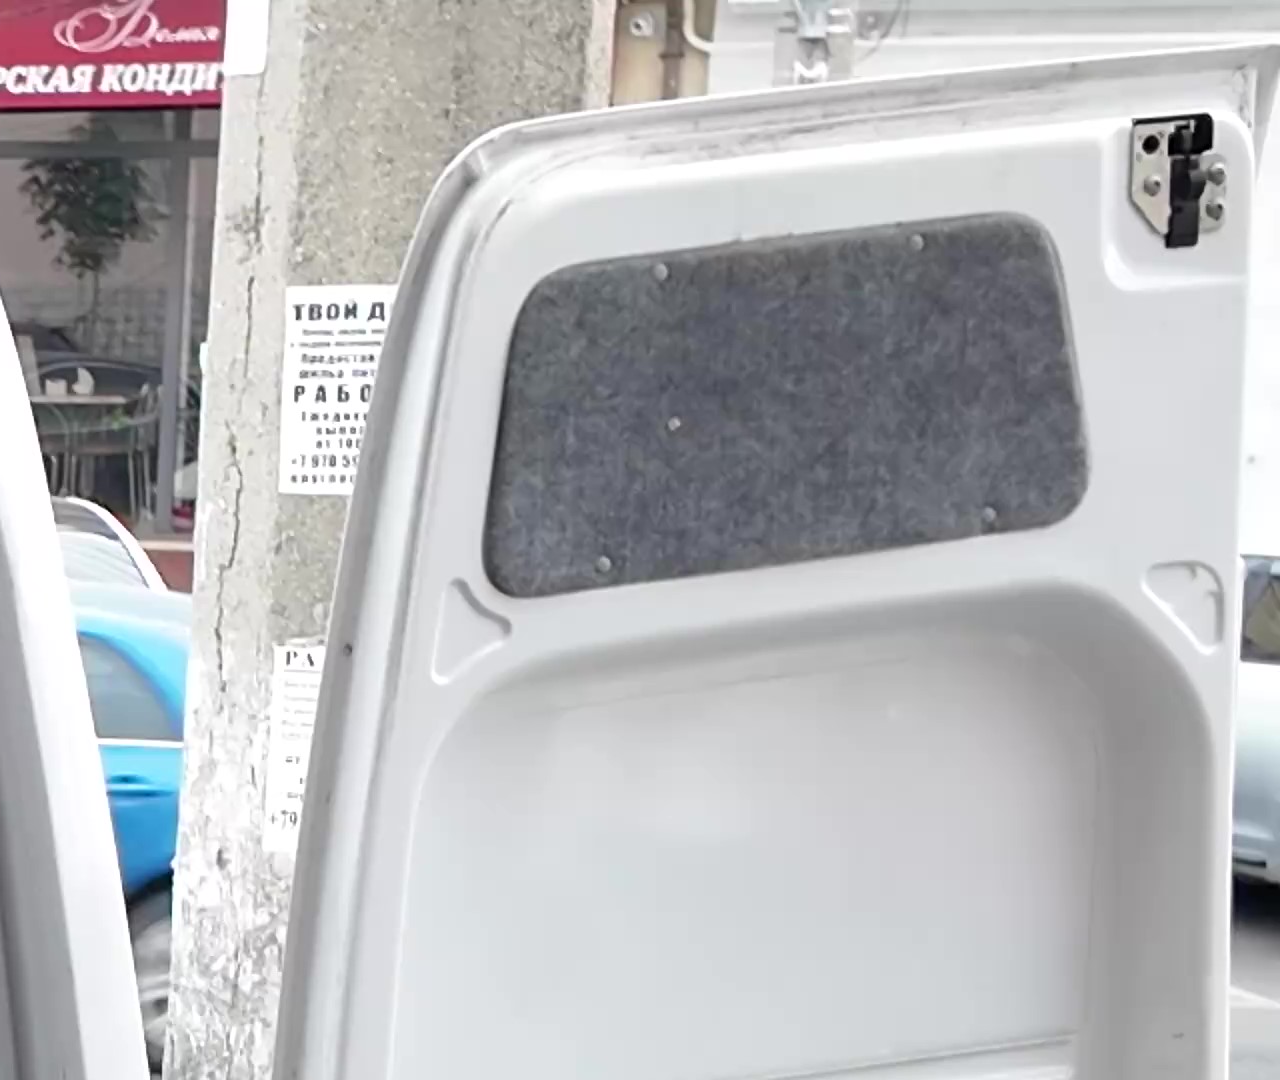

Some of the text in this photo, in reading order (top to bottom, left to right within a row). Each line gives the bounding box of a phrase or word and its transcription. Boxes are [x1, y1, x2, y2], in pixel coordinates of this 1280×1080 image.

[98, 61, 224, 96] КОНДИ
[292, 299, 358, 321] ТВОЙ
[293, 384, 373, 403] РАБО
